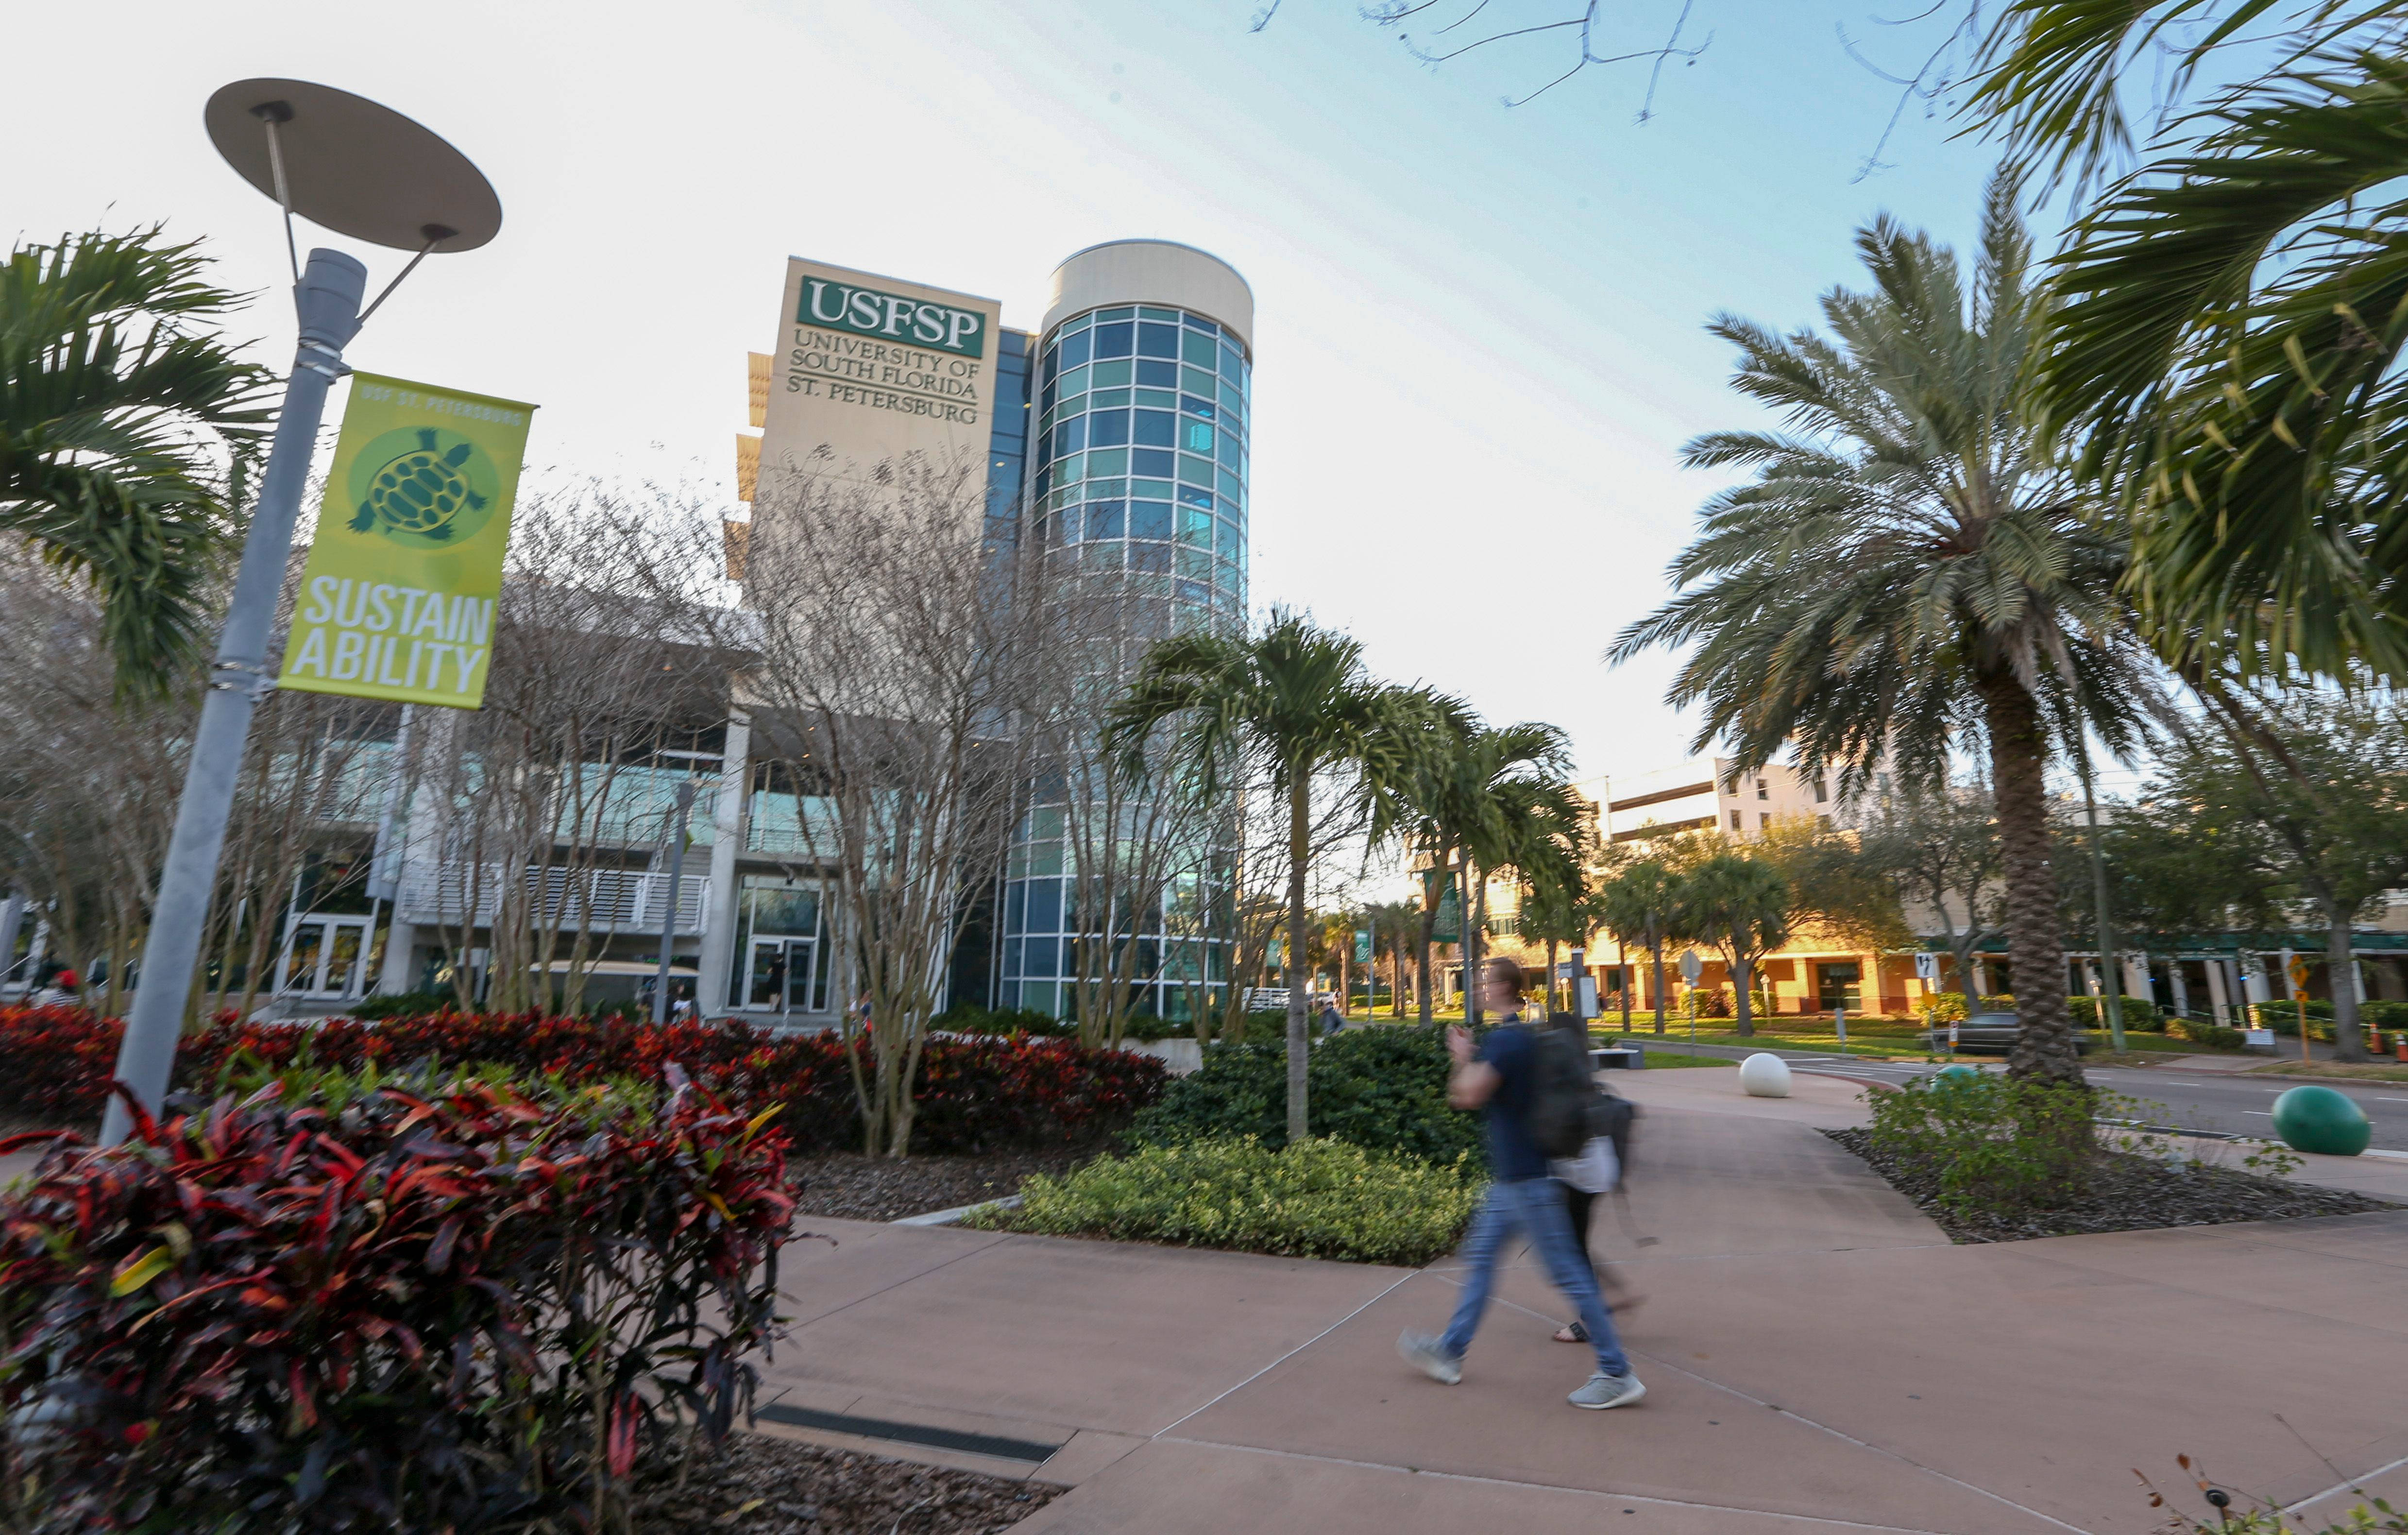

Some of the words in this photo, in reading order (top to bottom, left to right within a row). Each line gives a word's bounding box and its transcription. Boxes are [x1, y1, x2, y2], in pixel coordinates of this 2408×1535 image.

[808, 280, 980, 349] USFSP
[789, 348, 876, 380] SOUTH
[881, 364, 979, 399] FLORIDA
[794, 328, 944, 373] UNIVERSITY
[949, 359, 981, 379] OF
[361, 385, 392, 403] USF
[396, 390, 422, 409] ST.
[425, 396, 523, 426] PETERSBURG
[786, 375, 821, 397] ST.
[828, 382, 978, 425] PETERSBURG
[304, 575, 493, 646] SUSTAIN
[288, 627, 485, 694] ABILITY
